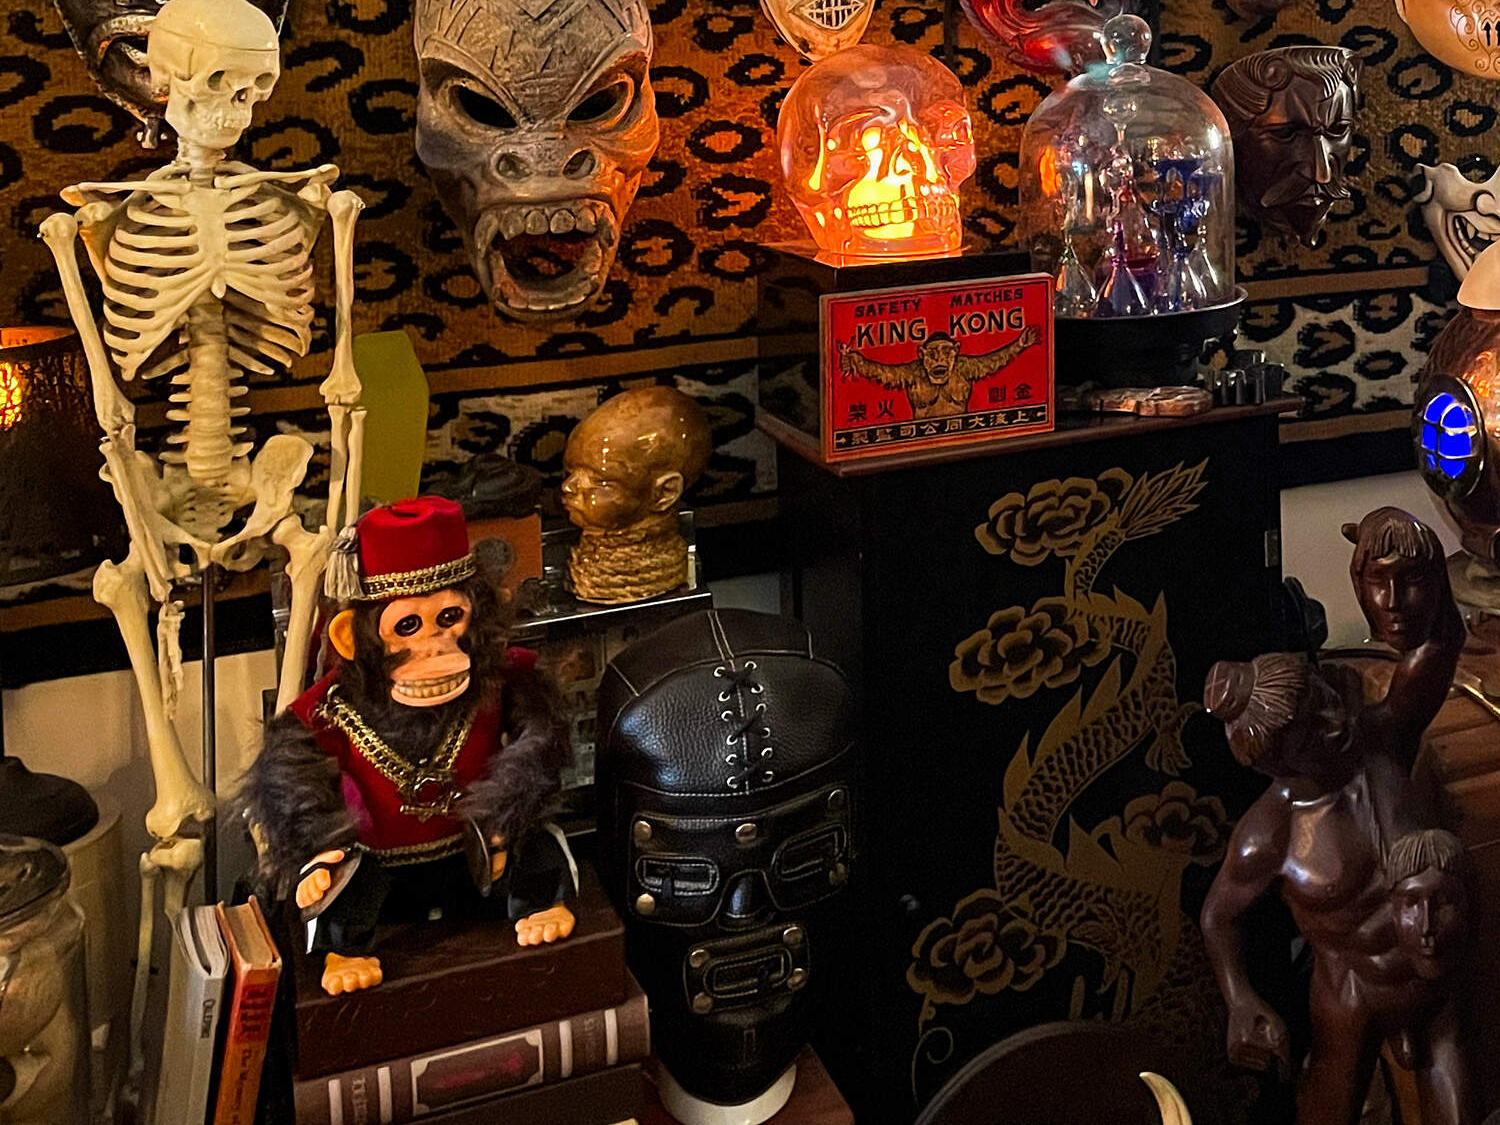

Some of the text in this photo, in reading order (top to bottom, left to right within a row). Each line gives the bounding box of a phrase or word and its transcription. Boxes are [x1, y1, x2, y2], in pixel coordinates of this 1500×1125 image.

[855, 288, 1024, 318] SAFETY MATCHES
[855, 307, 1025, 349] KING KONG
